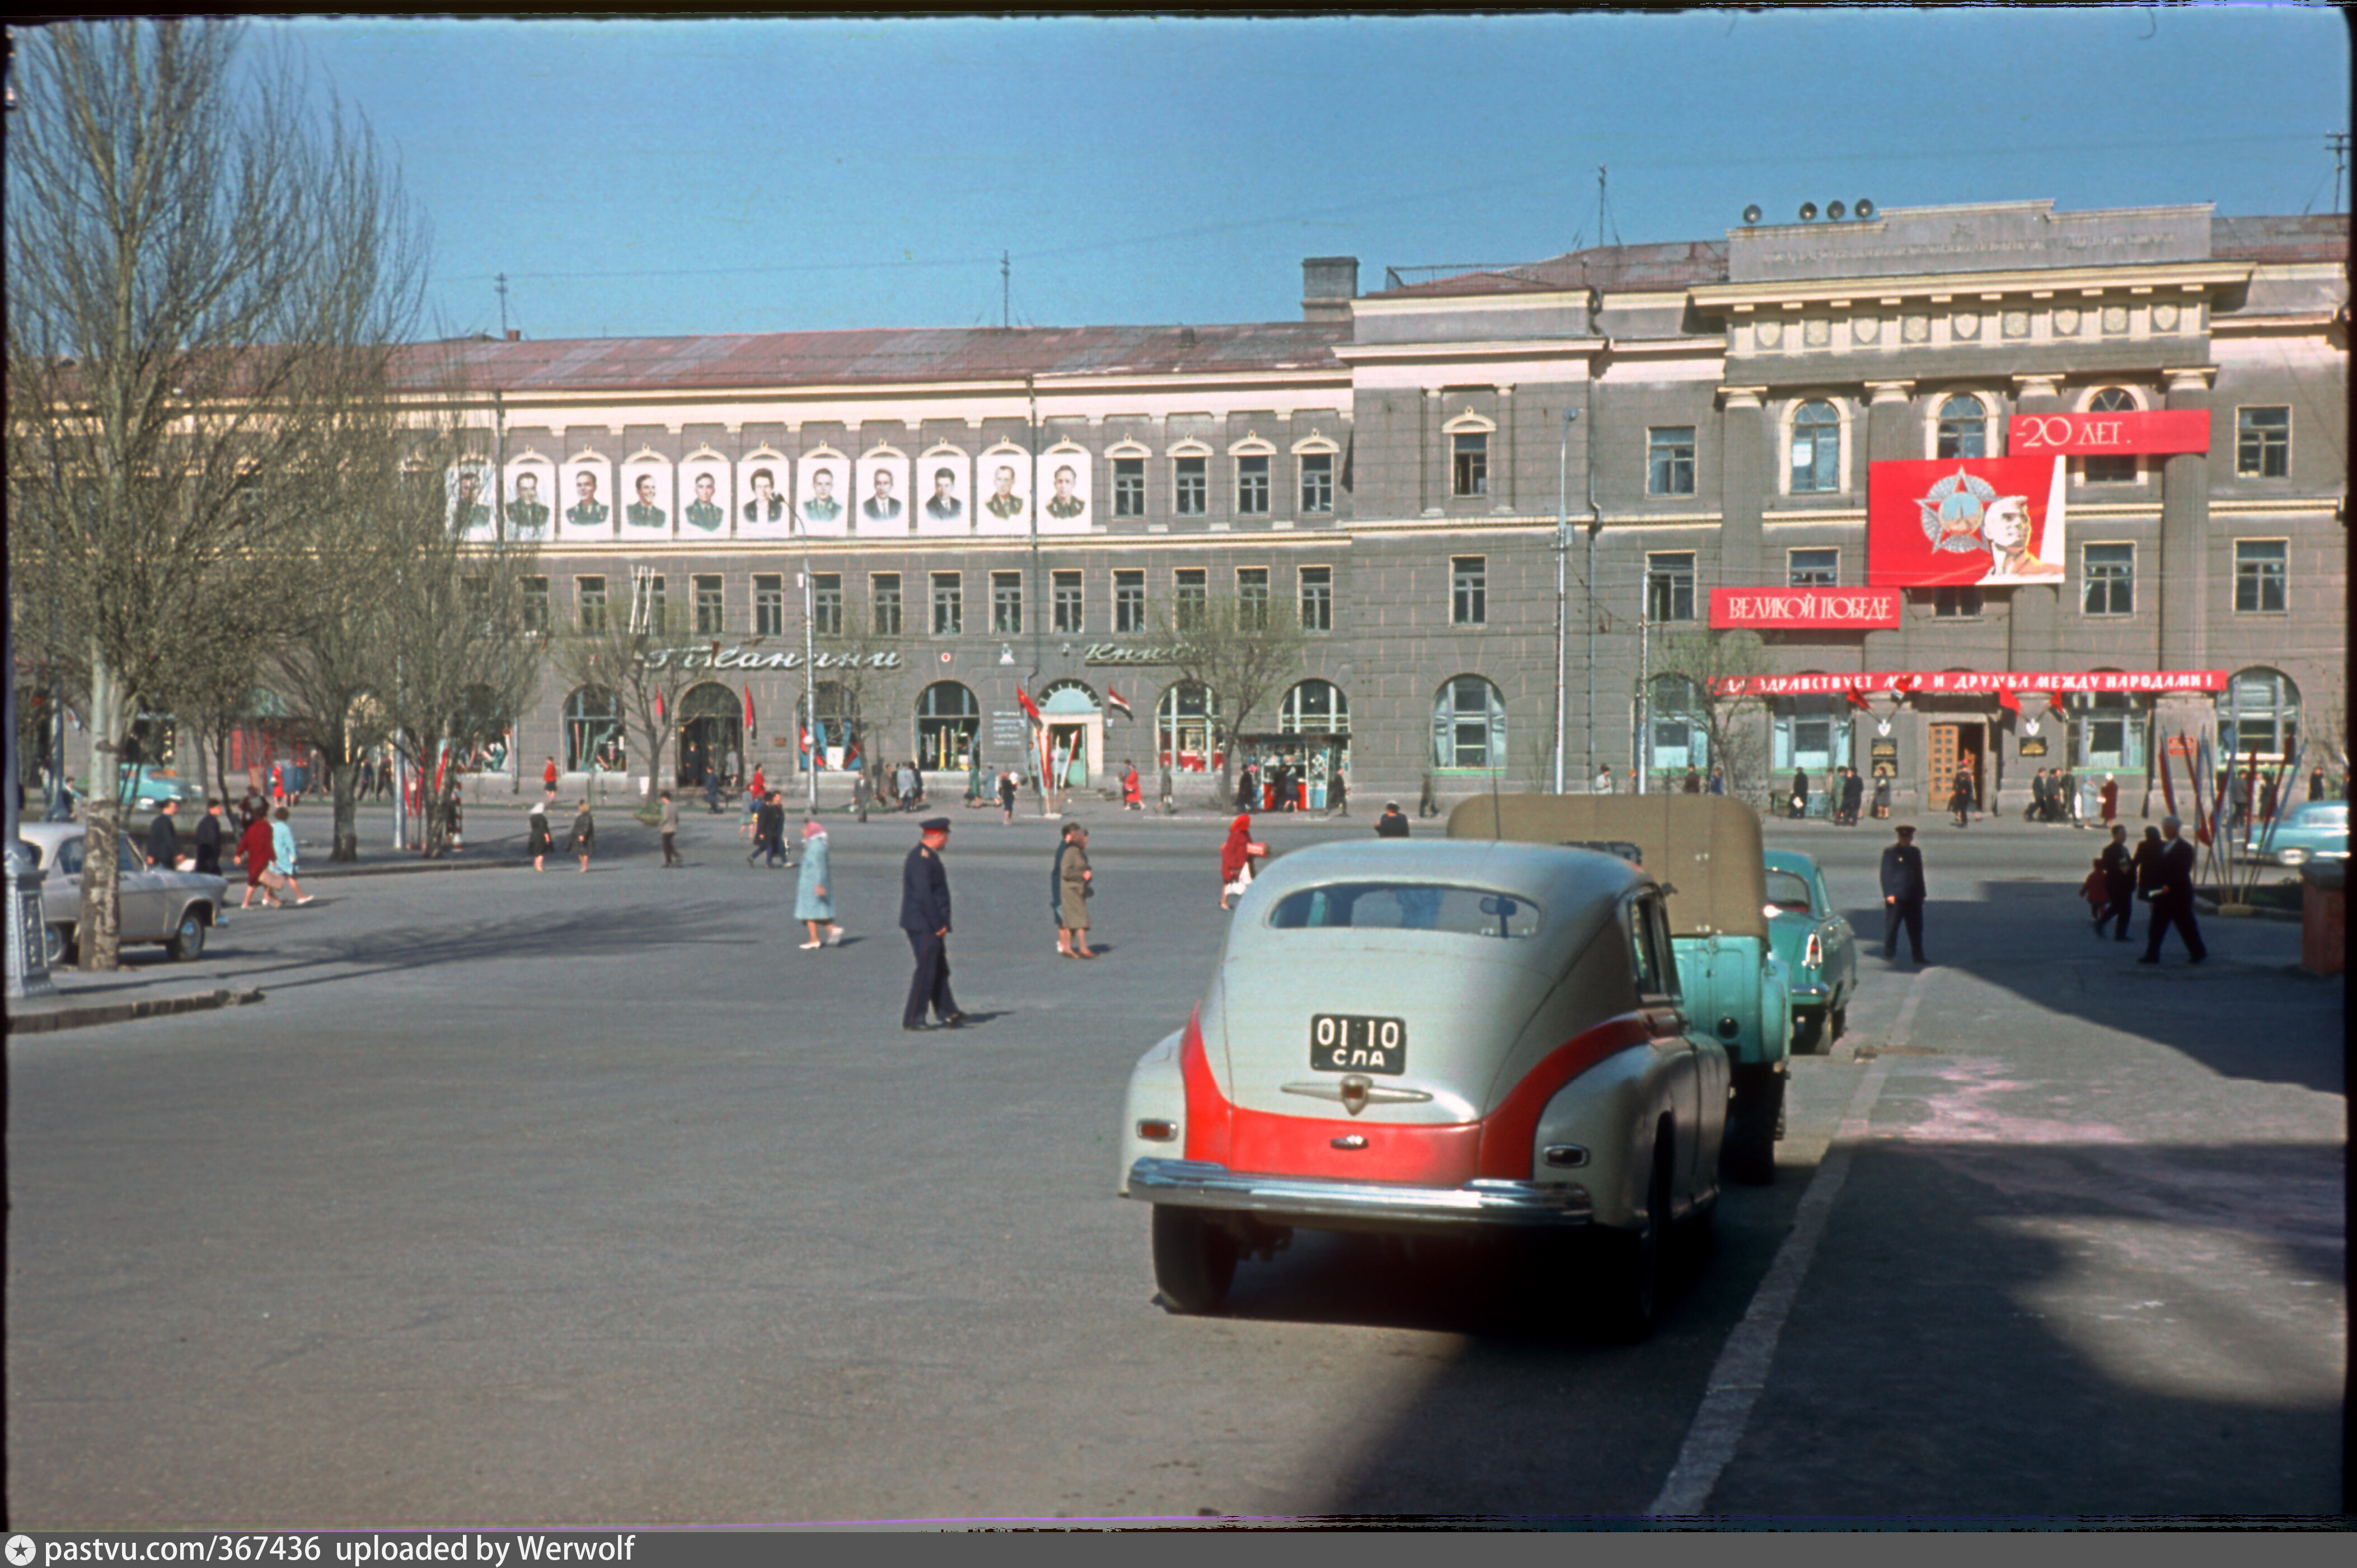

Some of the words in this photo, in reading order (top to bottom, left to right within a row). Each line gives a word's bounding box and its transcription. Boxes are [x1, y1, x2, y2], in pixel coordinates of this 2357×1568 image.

[1728, 592, 1817, 619] ВЕЛИКОЙ
[1820, 597, 1893, 621] ПОБЕДЕ
[1934, 675, 1944, 688] И
[1954, 675, 2028, 689] ДРУЖБА
[2035, 675, 2099, 689] МЕЖДУ
[1333, 1049, 1384, 1067] СЛА
